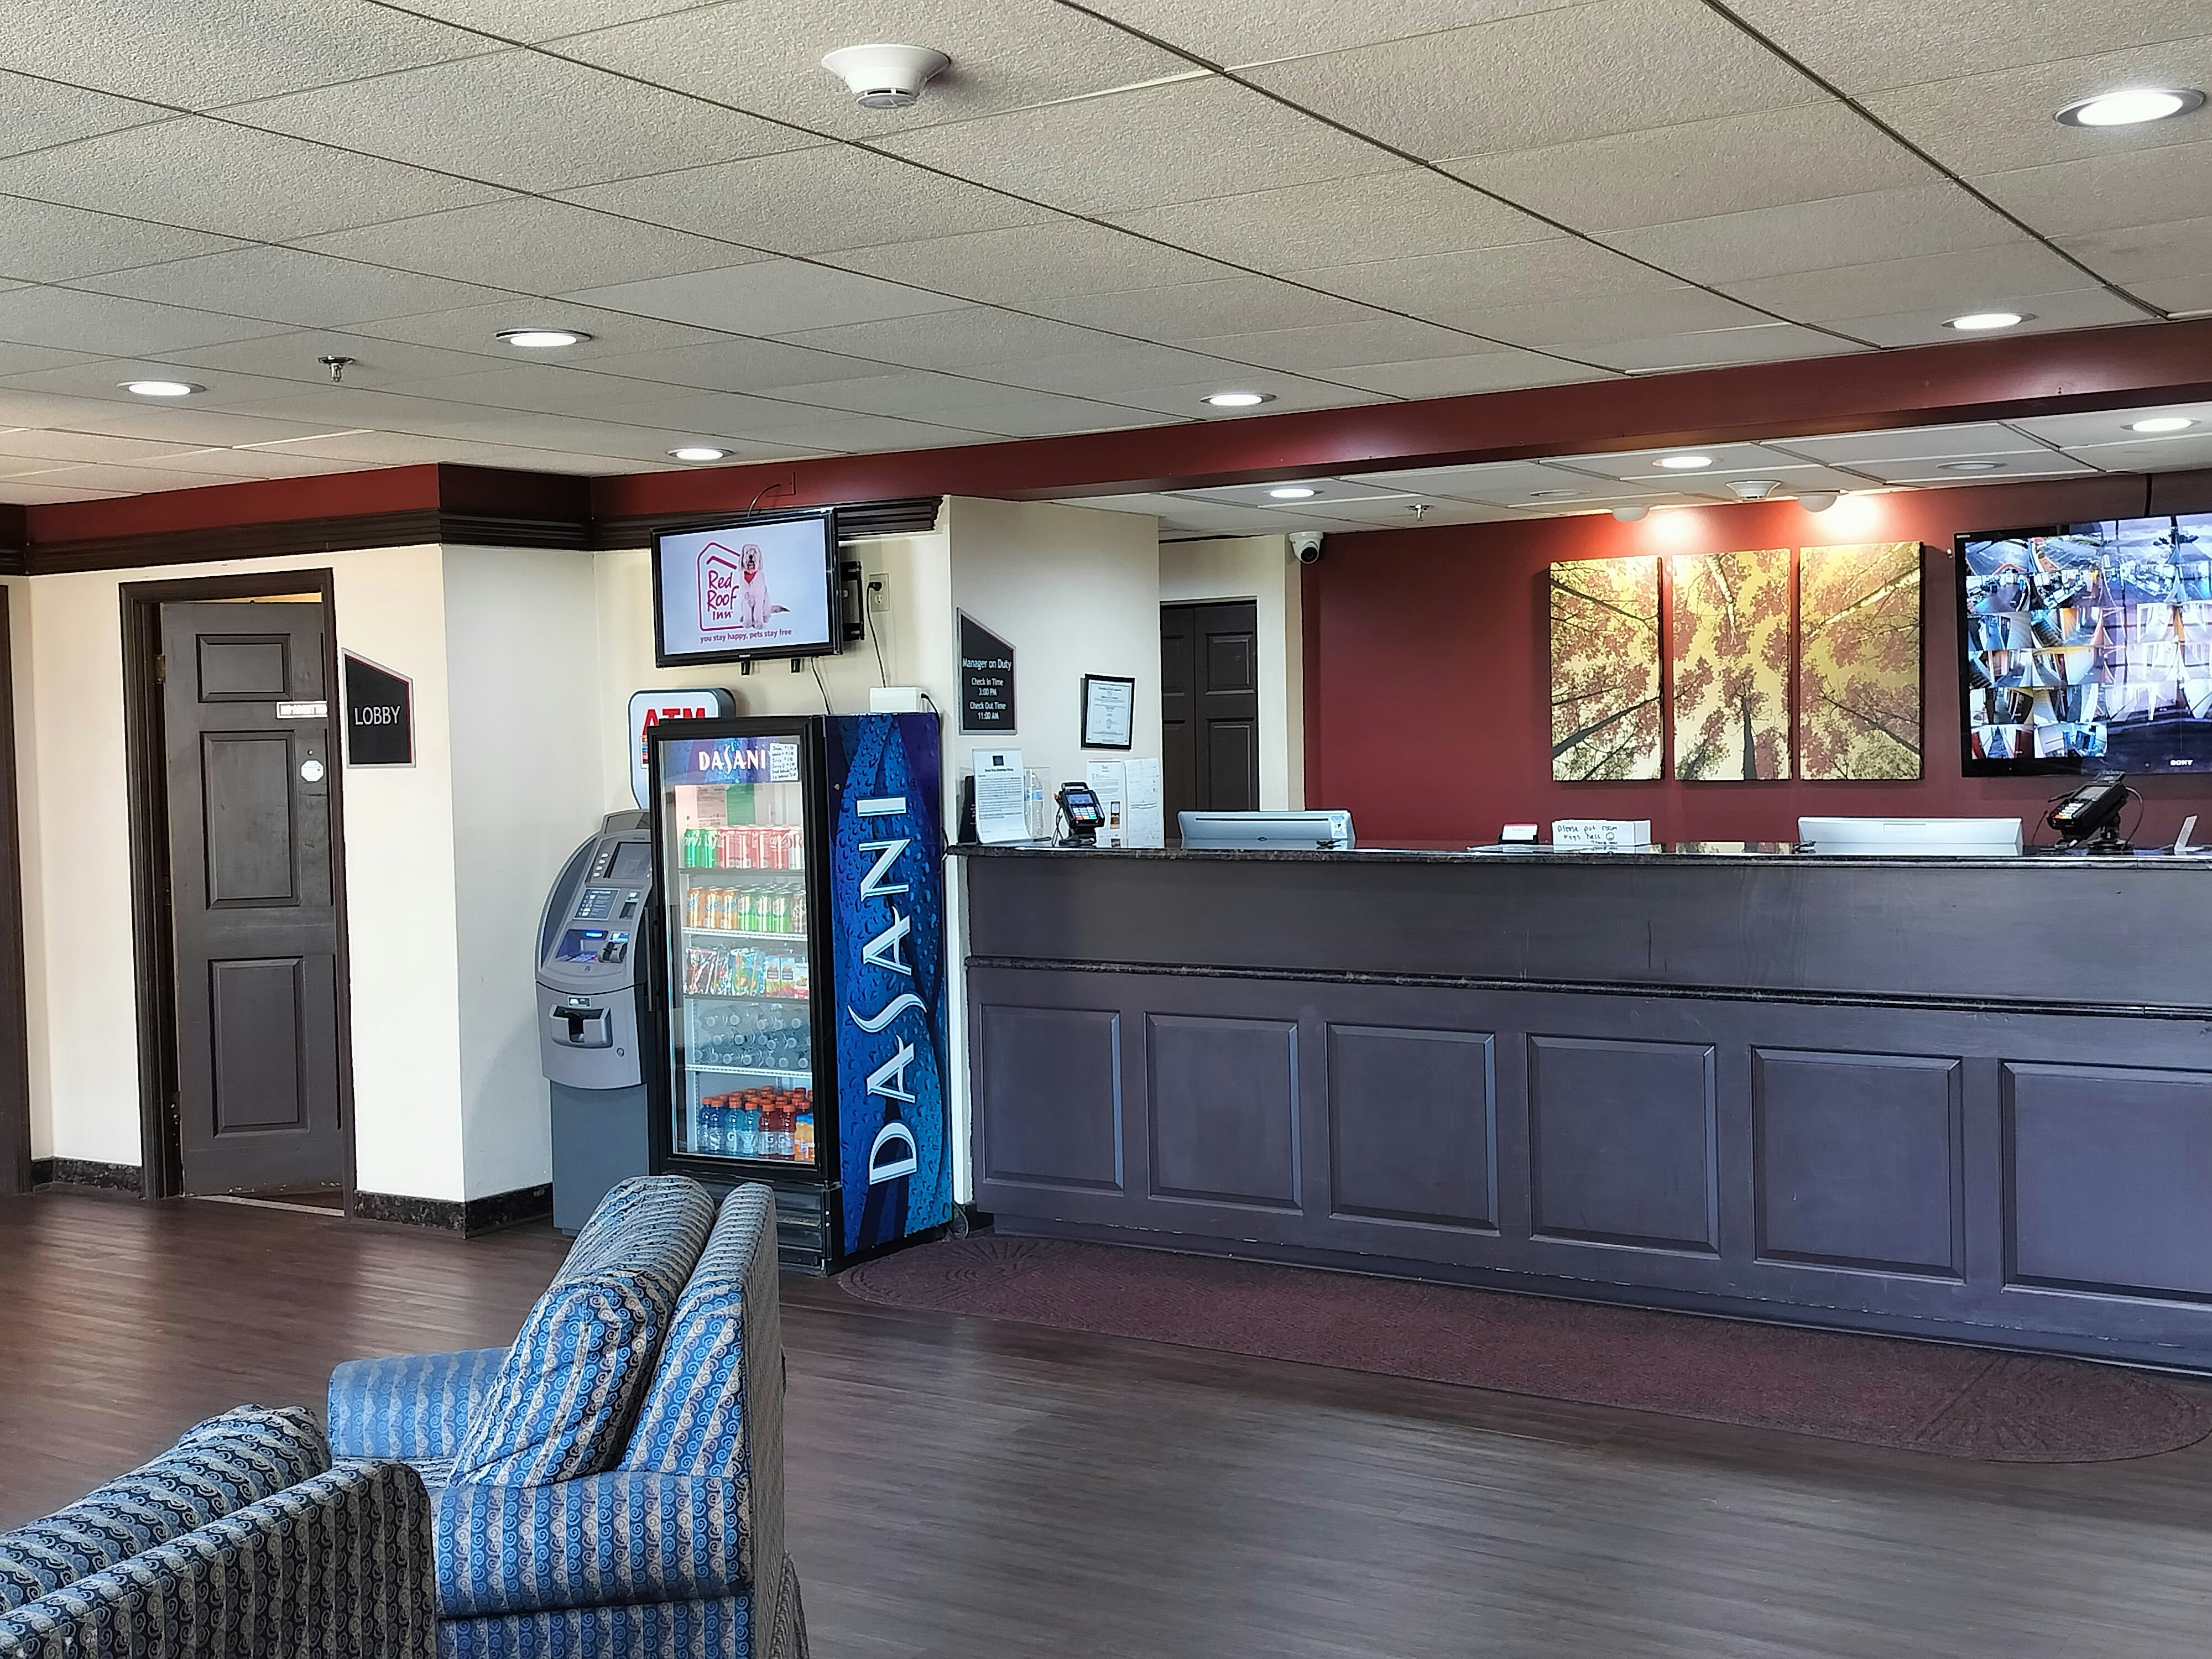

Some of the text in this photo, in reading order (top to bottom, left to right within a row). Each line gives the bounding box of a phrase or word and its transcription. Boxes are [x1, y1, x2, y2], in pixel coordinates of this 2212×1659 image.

[708, 570, 733, 590] Red
[707, 586, 739, 612] Roof
[712, 611, 731, 620] Inn
[713, 634, 726, 642] stay
[749, 632, 763, 640] pets
[963, 658, 1011, 671] Manager on Duty
[971, 677, 985, 686] Check
[992, 678, 1004, 686] Time
[970, 701, 984, 709] Check
[354, 706, 400, 725] LOBBY
[698, 744, 766, 775] DASANI
[847, 797, 927, 1185] DASANI
